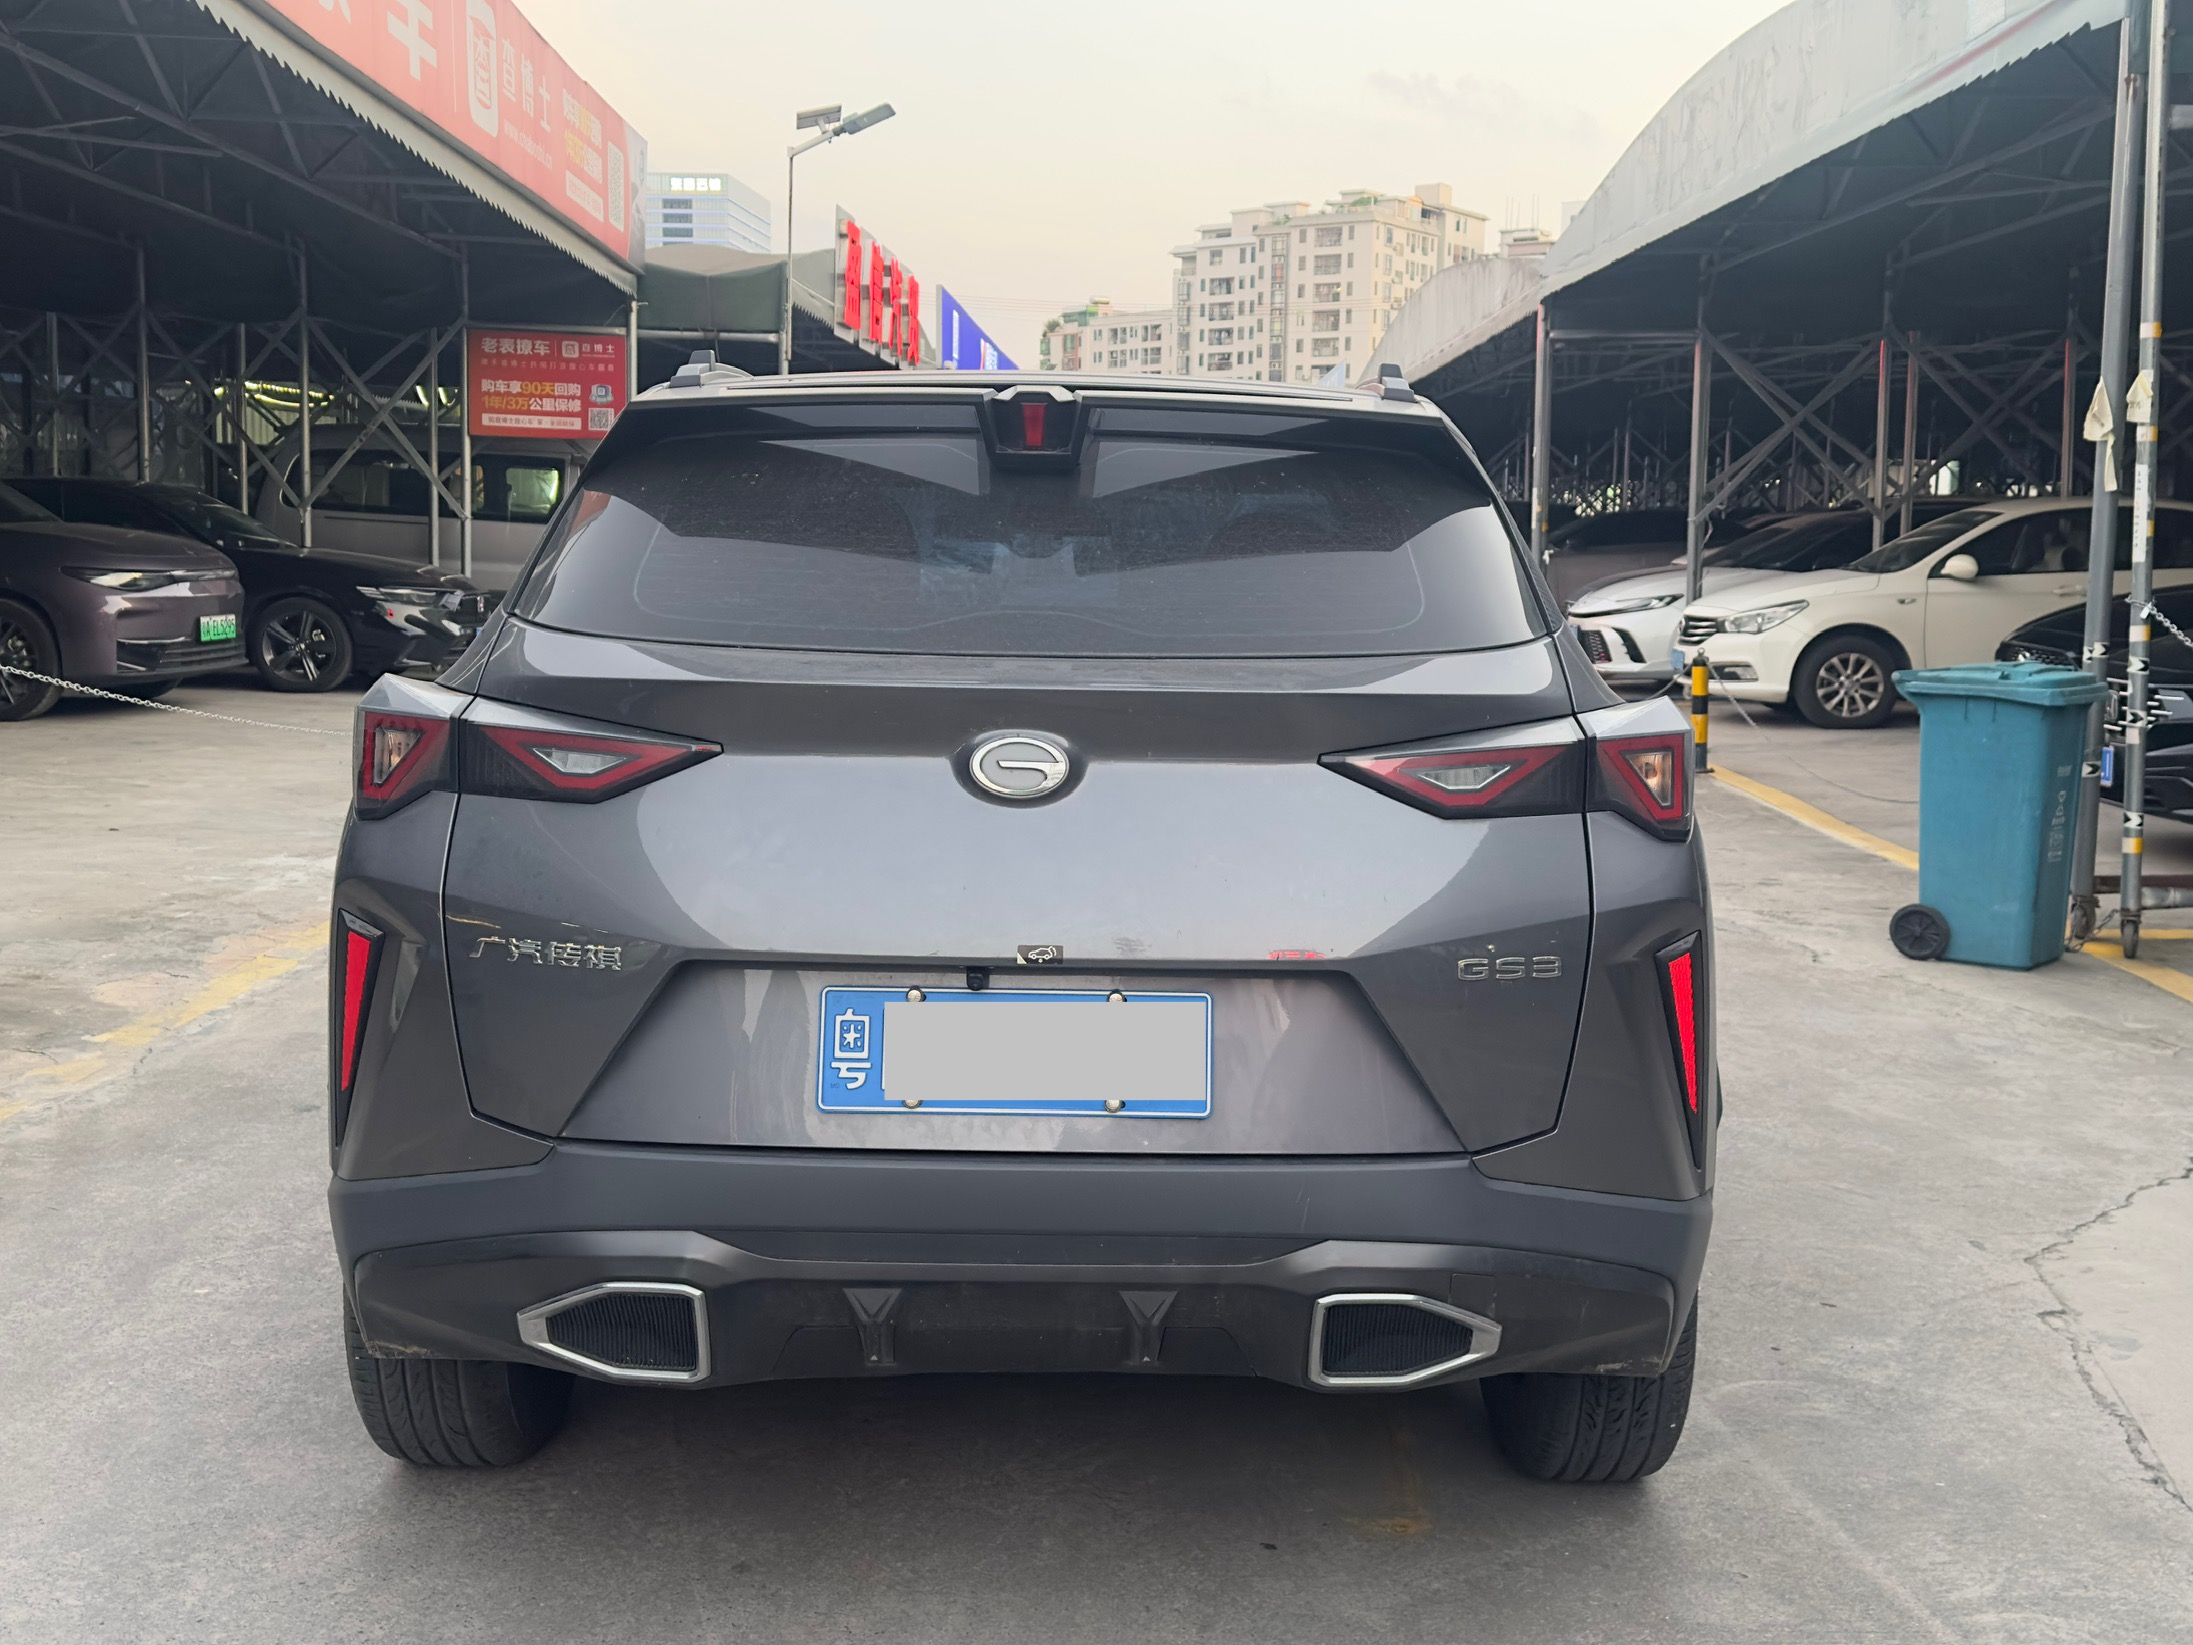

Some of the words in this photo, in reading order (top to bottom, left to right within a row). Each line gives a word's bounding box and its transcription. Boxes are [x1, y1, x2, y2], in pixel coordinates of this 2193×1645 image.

[481, 379, 582, 397] 购车享90天回购
[484, 394, 582, 412] 1年/3万公里保修
[469, 936, 622, 971] 广汽传祺
[1457, 955, 1562, 981] GS3
